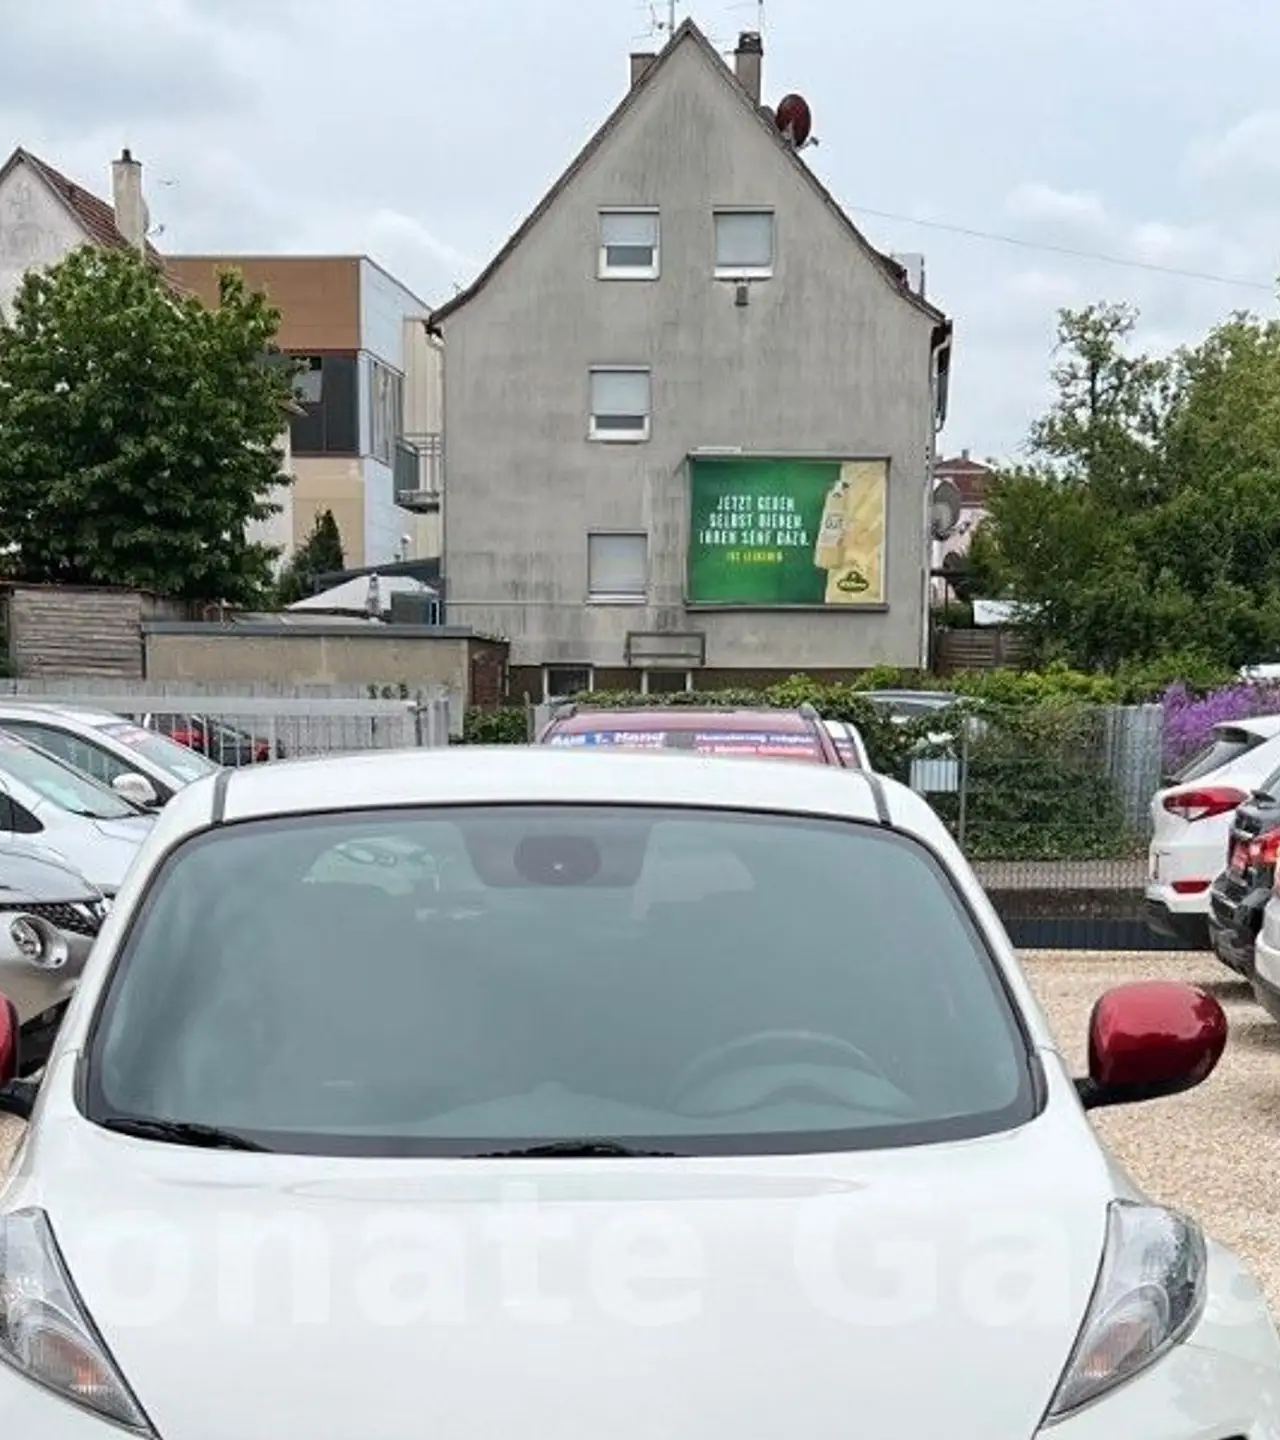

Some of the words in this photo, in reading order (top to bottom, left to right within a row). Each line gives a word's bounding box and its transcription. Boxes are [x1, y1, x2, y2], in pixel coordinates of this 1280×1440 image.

[716, 494, 753, 511] JETZT
[709, 512, 753, 529] SELBST
[741, 530, 772, 546] SENF
